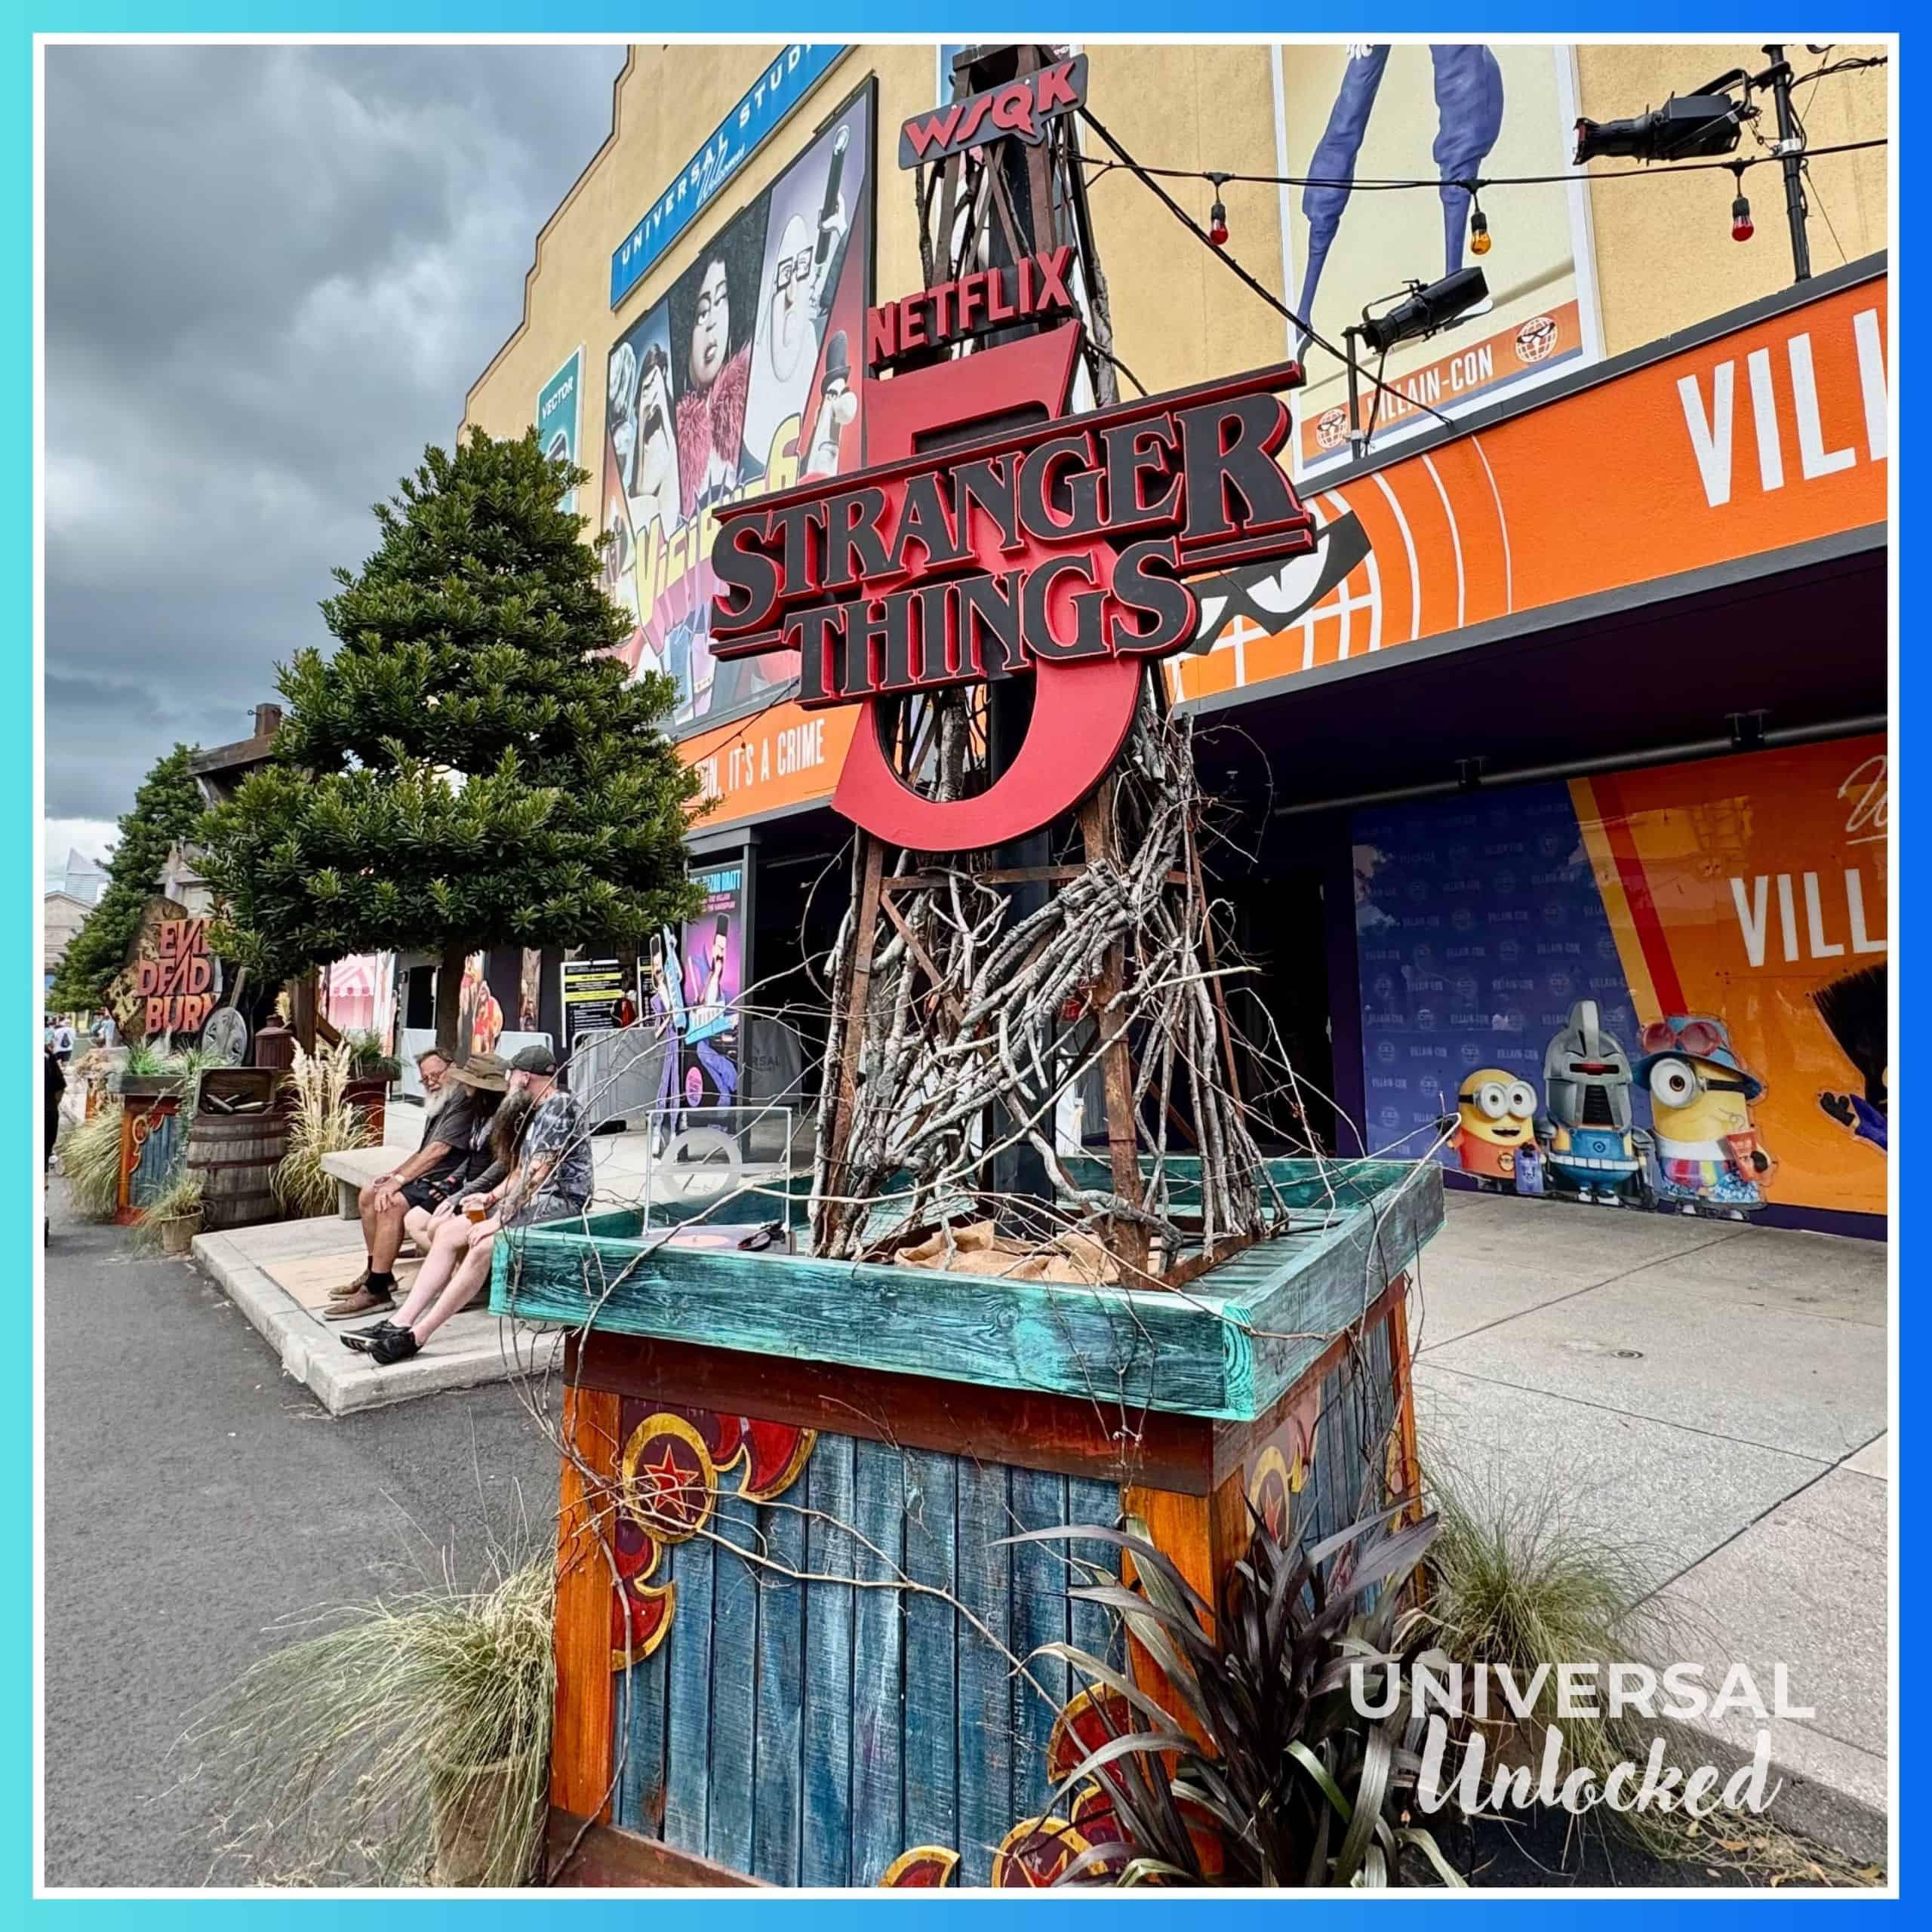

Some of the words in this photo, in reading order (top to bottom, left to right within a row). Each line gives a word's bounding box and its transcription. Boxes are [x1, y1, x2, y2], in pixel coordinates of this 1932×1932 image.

[905, 60, 1078, 158] WSQK
[622, 132, 729, 266] UNIVERSAL
[868, 247, 1076, 365] NETFLIX
[543, 376, 573, 420] VECTOR
[712, 392, 1307, 632] STRANGER
[785, 538, 1198, 706] THINGS
[729, 743, 755, 792] IT'S
[761, 737, 770, 782] A
[777, 718, 825, 776] CRIME
[137, 954, 212, 996] DEAD
